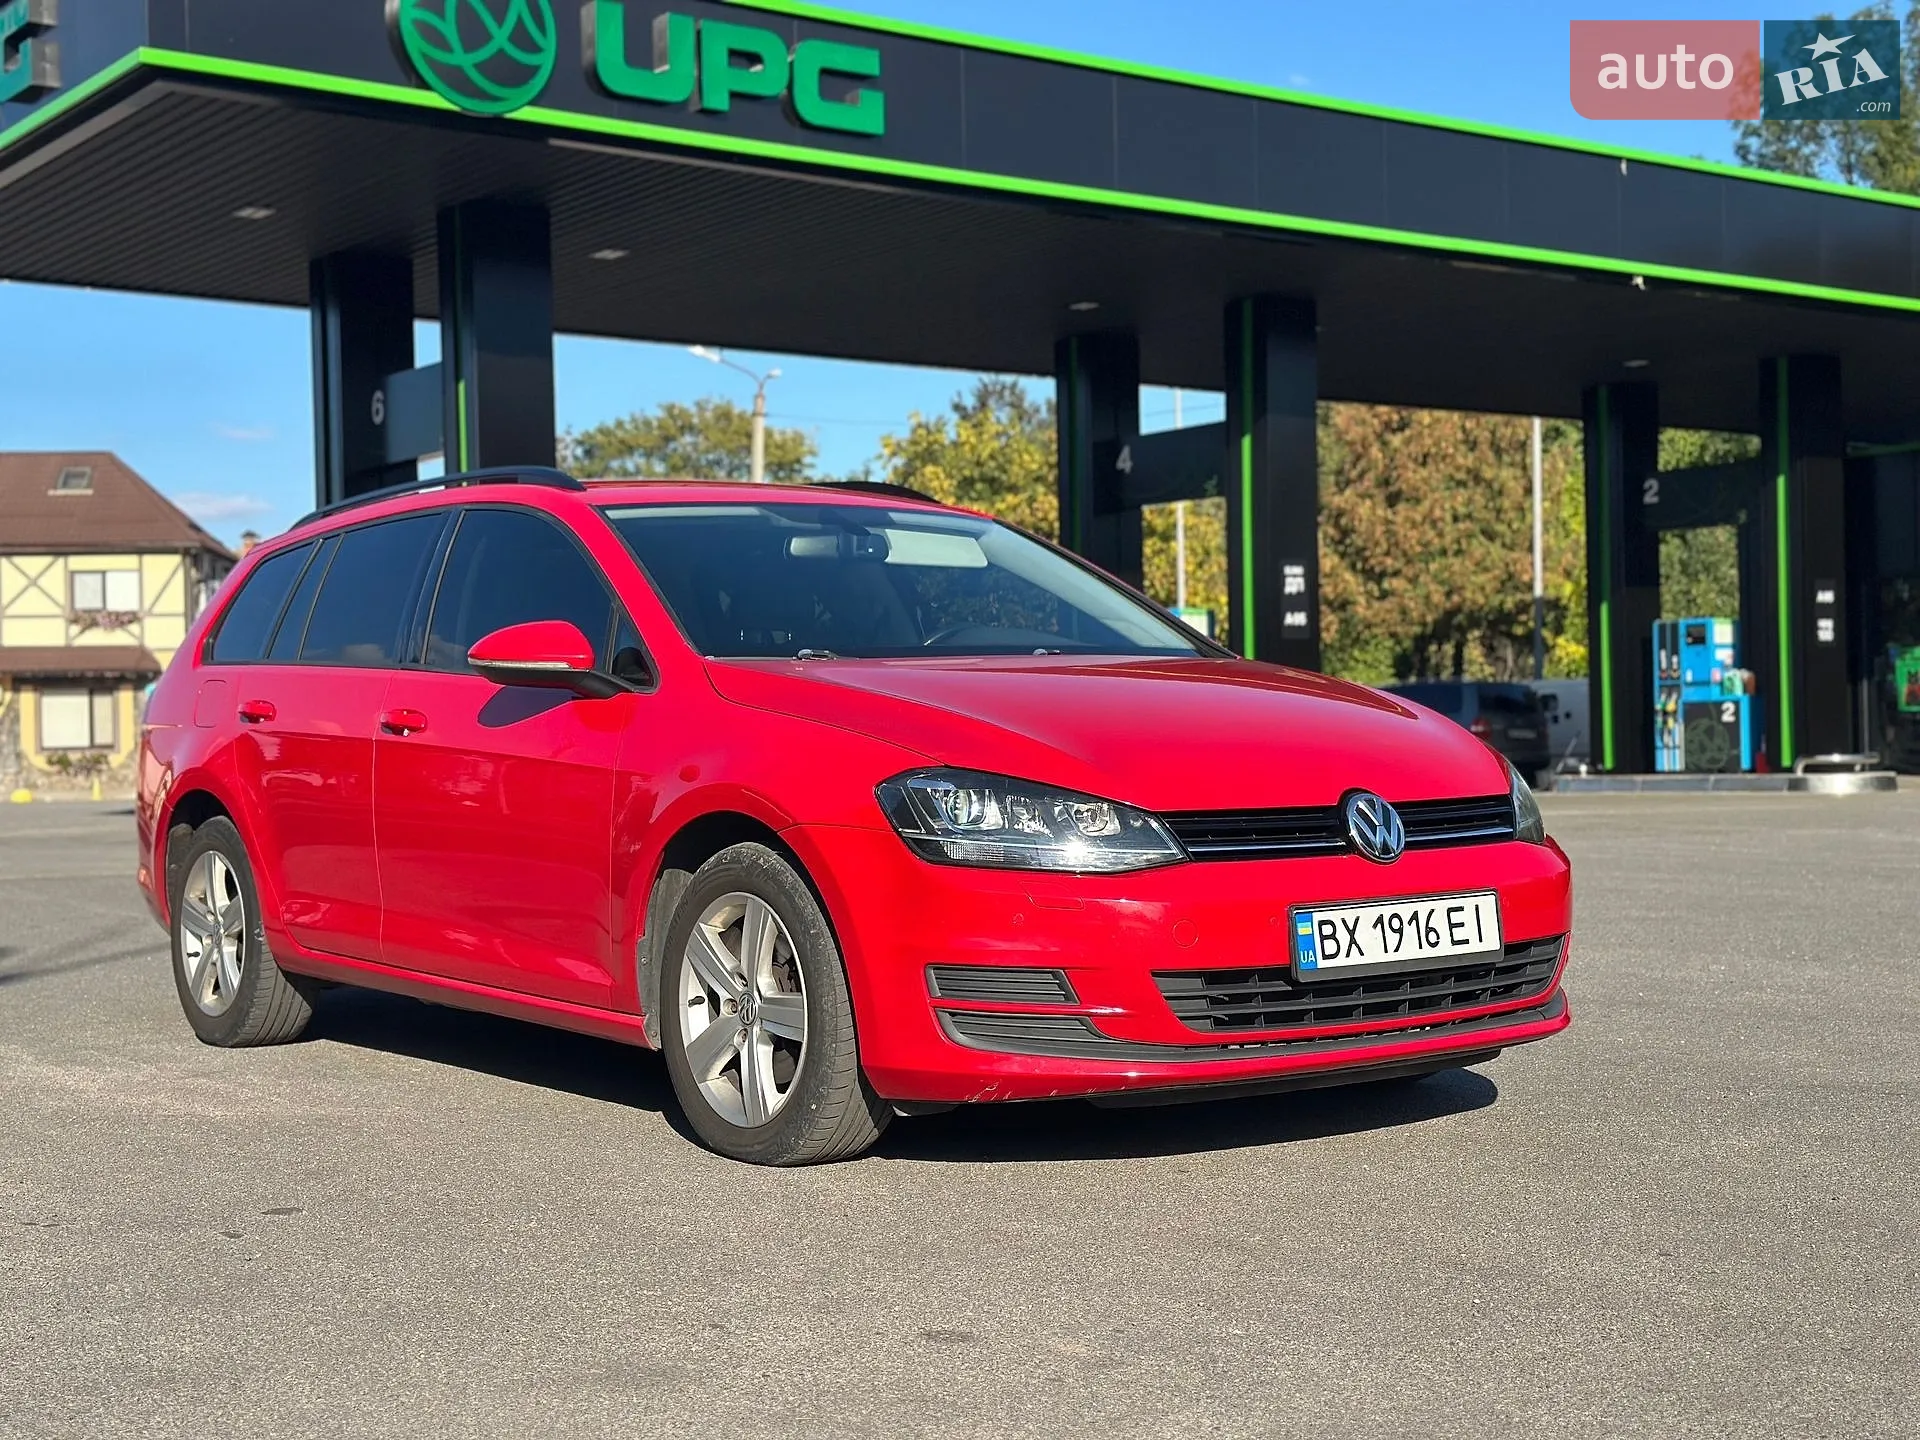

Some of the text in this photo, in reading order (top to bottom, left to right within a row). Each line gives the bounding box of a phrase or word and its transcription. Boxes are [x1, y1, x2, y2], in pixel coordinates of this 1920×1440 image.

[590, 1, 885, 136] UPG
[371, 389, 385, 425] 6
[1115, 444, 1134, 474] 4
[1643, 478, 1660, 505] 2
[1721, 701, 1736, 723] 2
[1318, 904, 1484, 961] BX 1916 EI
[1300, 949, 1316, 964] UA
